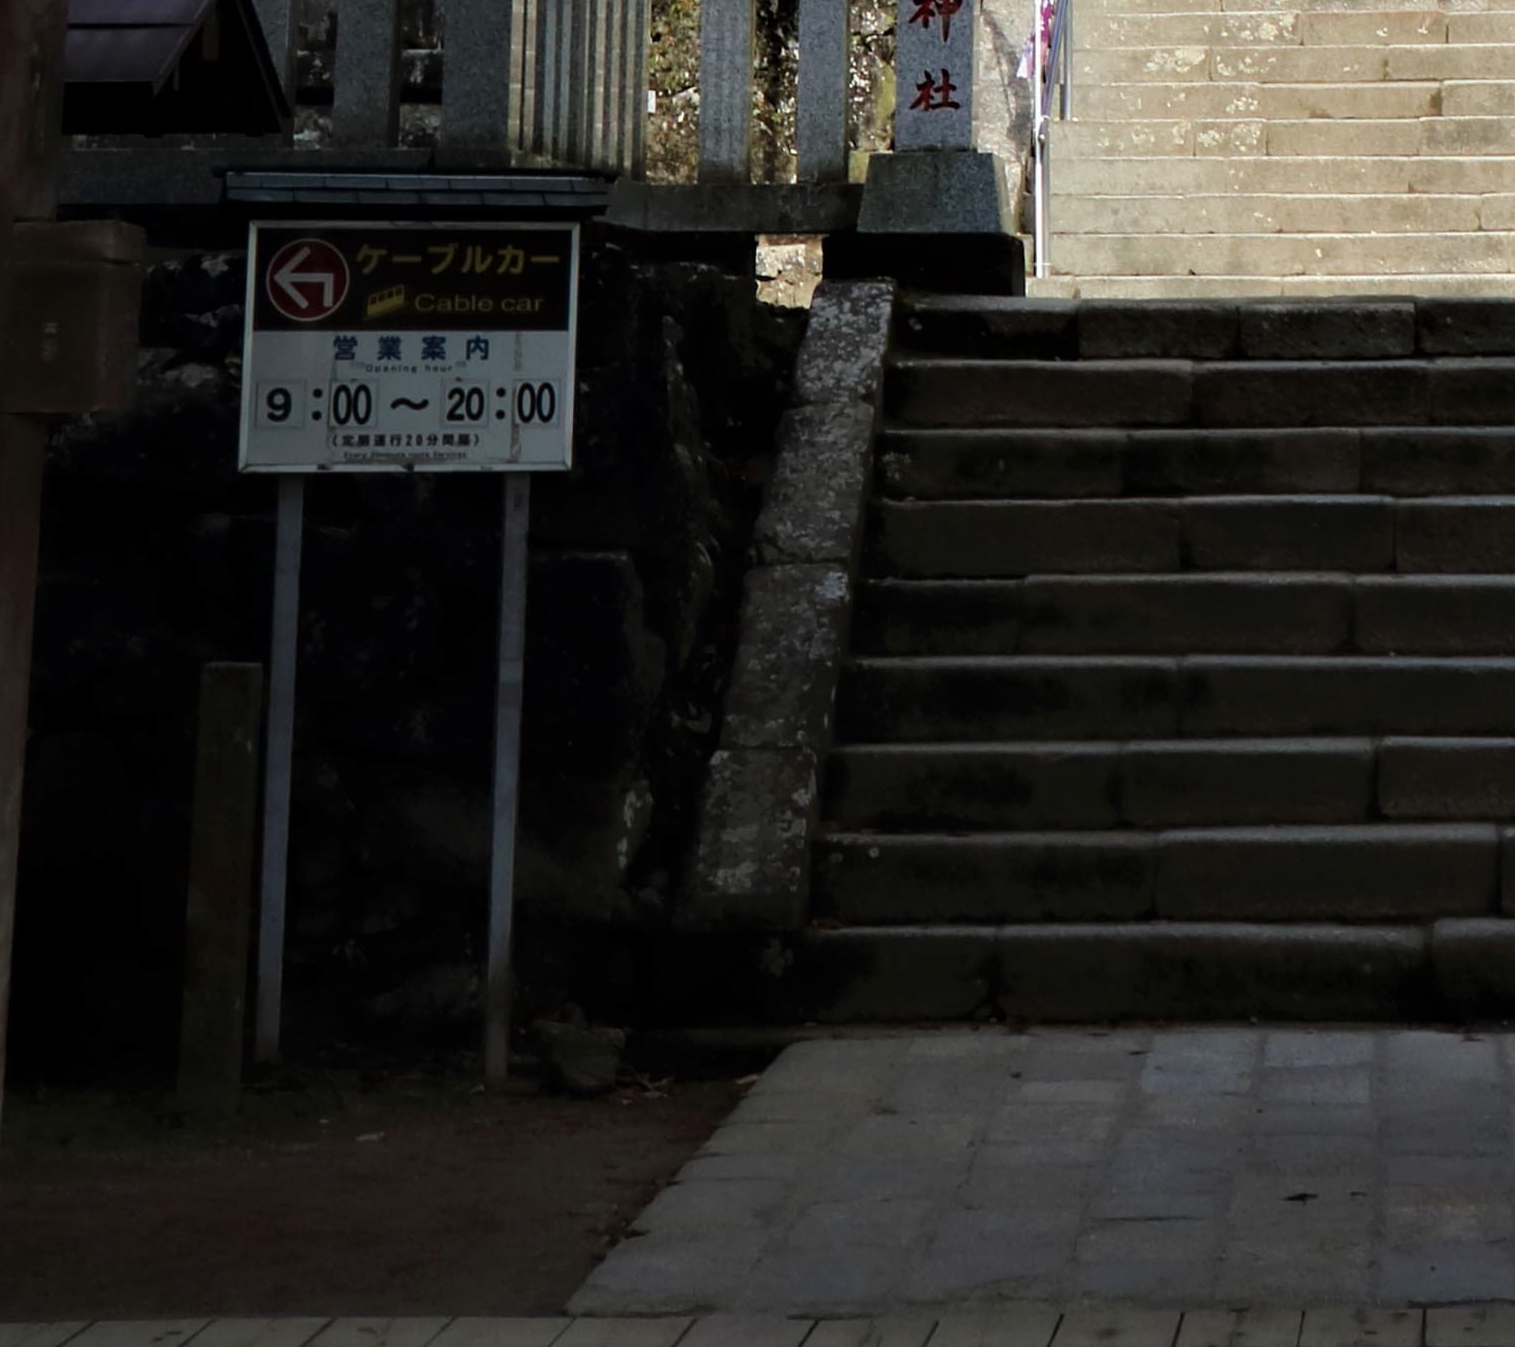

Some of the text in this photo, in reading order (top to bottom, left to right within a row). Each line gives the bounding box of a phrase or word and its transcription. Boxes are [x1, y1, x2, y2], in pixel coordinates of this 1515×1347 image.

[353, 242, 563, 276] ケーブルカー
[413, 291, 546, 314] Cable car
[331, 335, 491, 361] 営業案内
[364, 363, 454, 375] Opening hour
